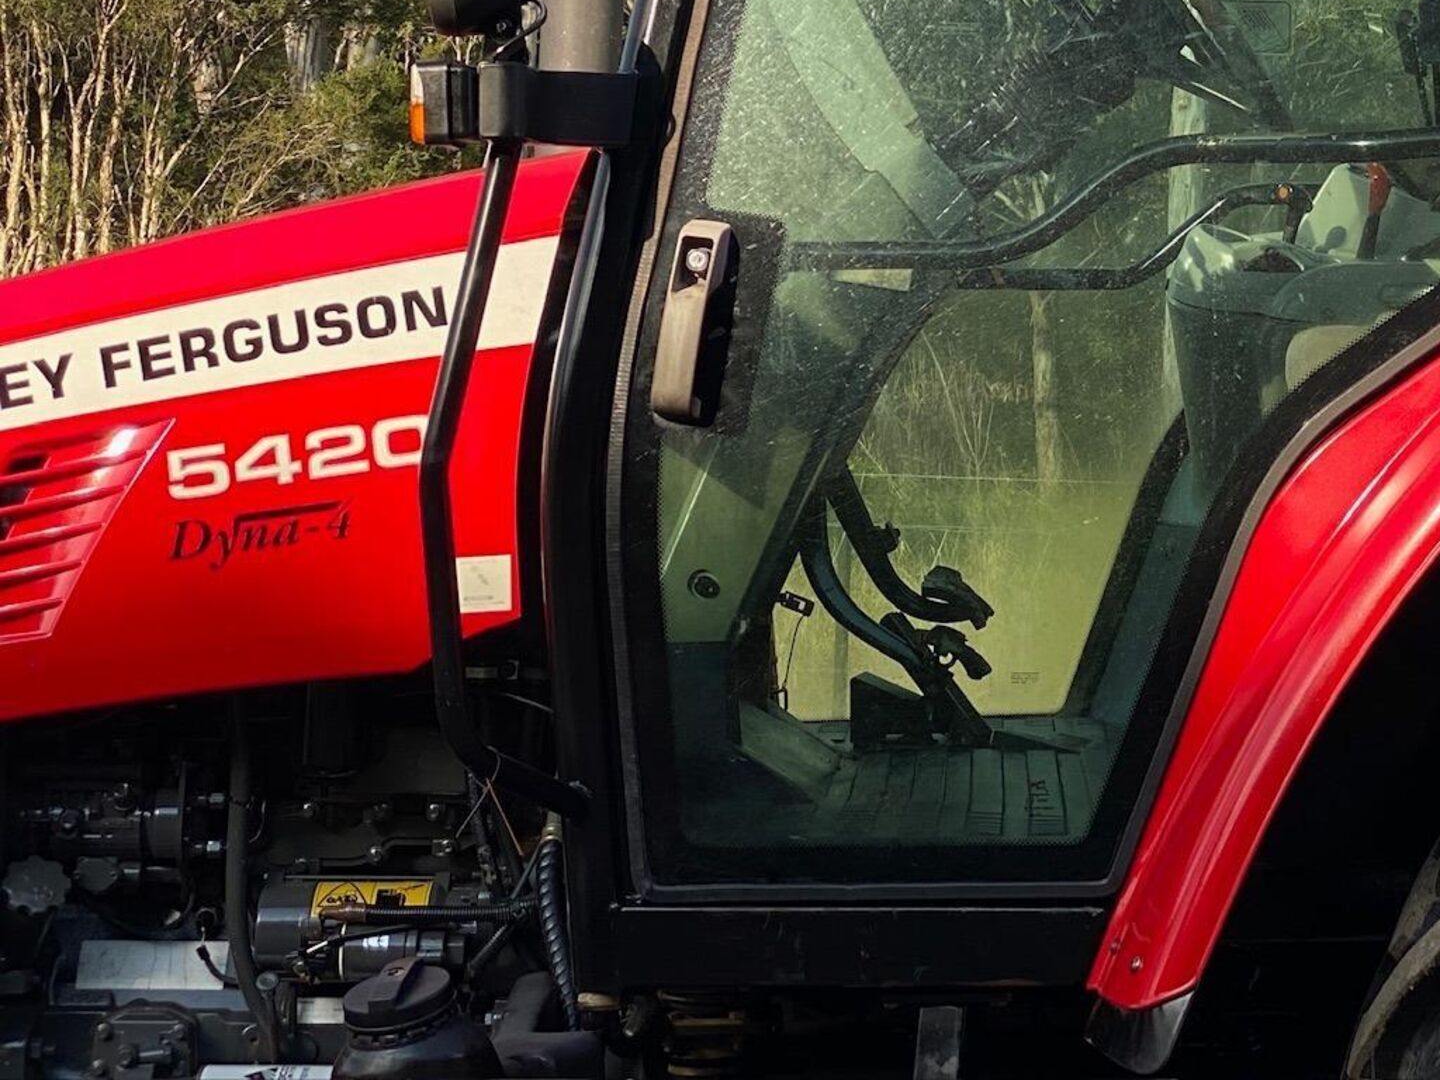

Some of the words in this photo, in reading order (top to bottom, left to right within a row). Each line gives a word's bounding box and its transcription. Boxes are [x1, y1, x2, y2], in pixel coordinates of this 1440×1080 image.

[99, 286, 449, 389] FERGUSON
[167, 414, 429, 500] 5420
[169, 498, 353, 570] Dyna-4
